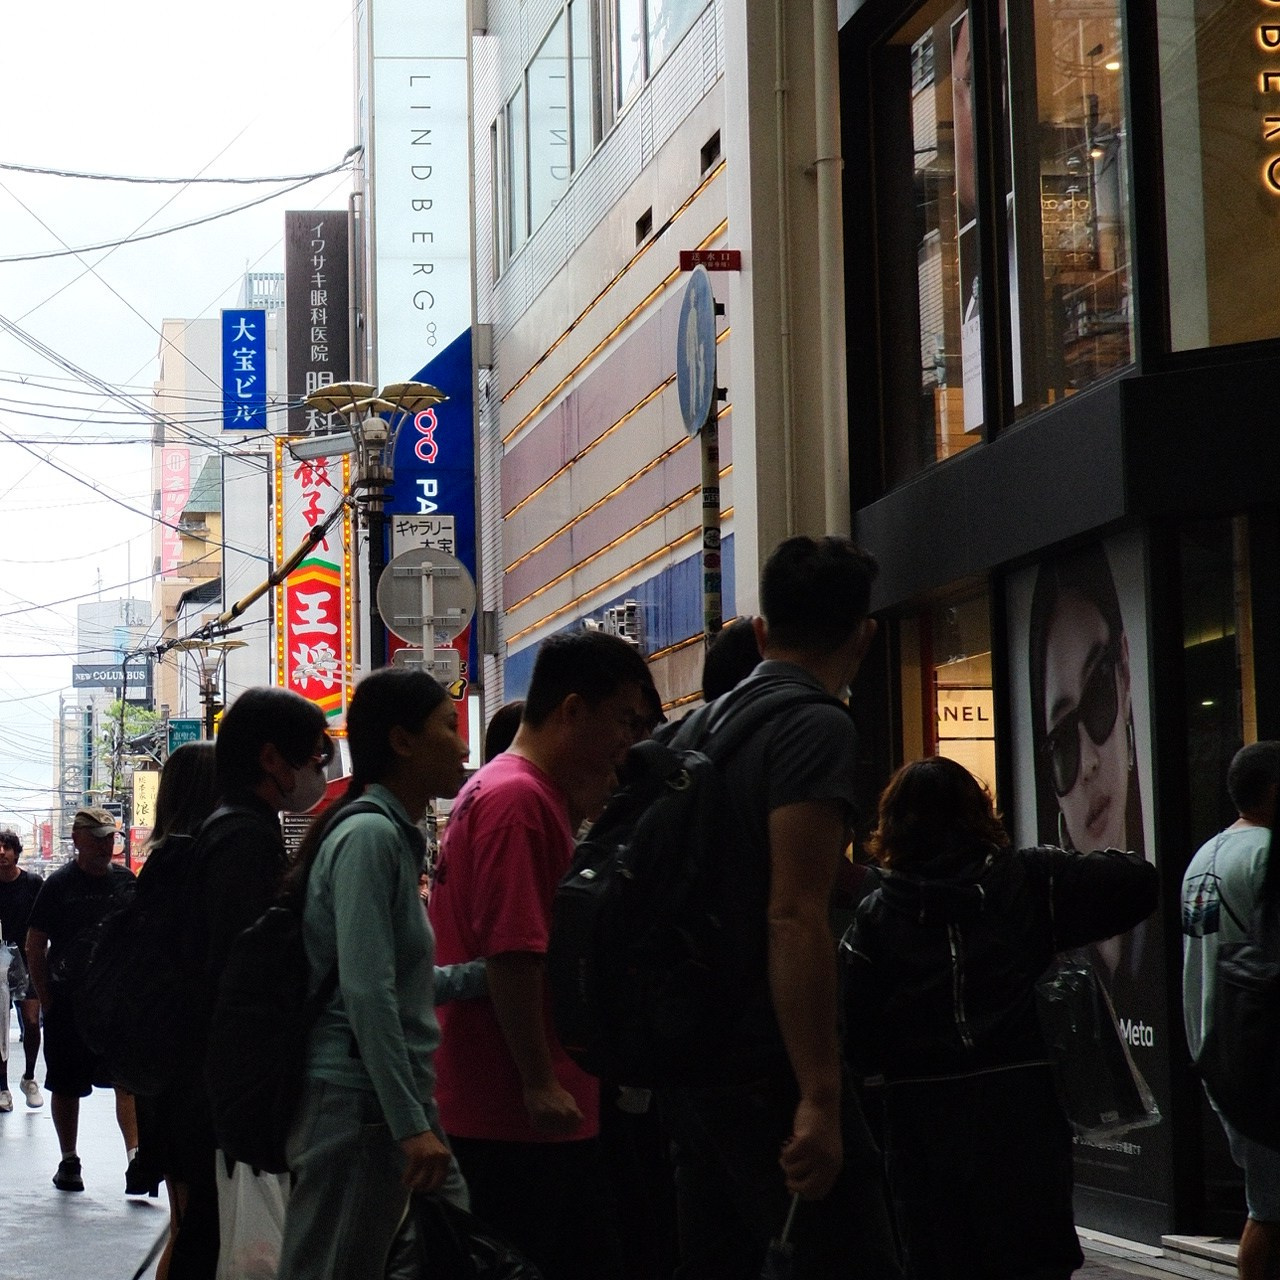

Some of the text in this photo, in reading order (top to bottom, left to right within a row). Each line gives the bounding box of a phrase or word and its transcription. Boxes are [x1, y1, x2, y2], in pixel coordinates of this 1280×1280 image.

[410, 75, 434, 310] LINDBERG
[310, 222, 329, 362] イワサキ眼科医院
[692, 251, 730, 262] 送水口
[232, 317, 257, 423] 大宝ビル
[396, 521, 452, 536] ギャラリー
[291, 591, 338, 690] 王将
[1119, 1018, 1154, 1048] Meta
